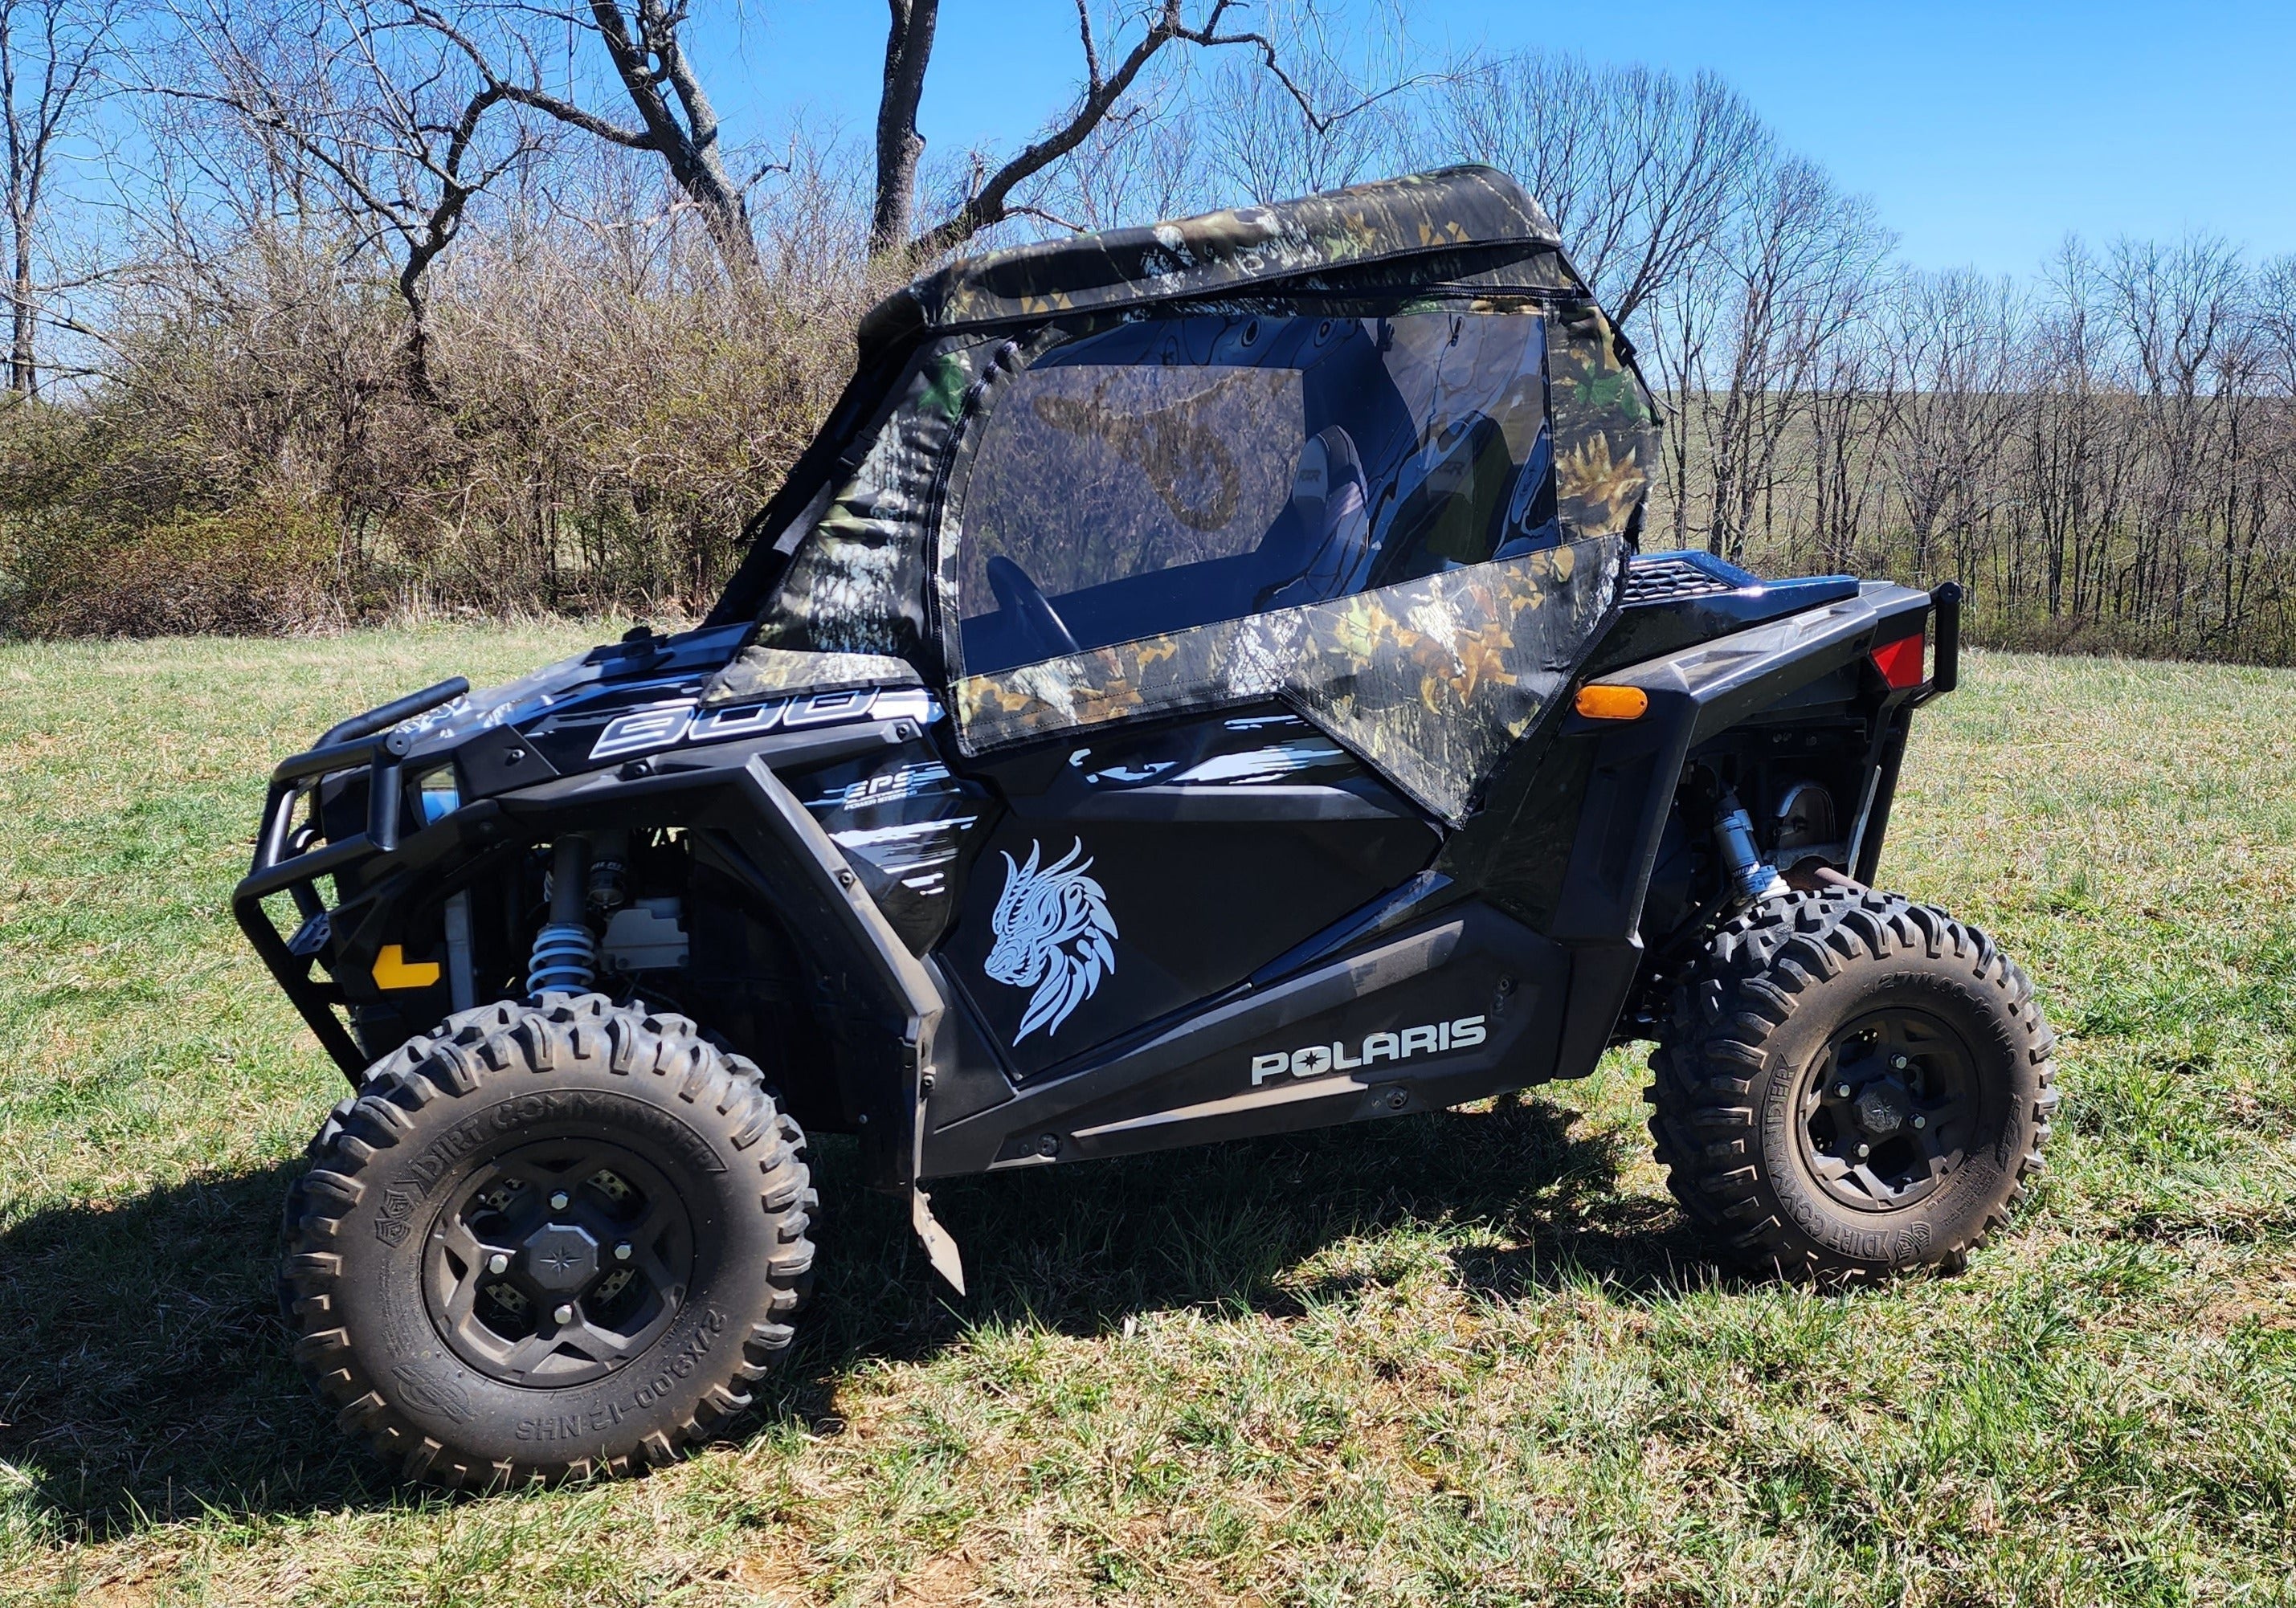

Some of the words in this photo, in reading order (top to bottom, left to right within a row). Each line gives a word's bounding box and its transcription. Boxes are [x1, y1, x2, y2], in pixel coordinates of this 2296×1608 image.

[844, 770, 916, 798] EPS
[844, 799, 876, 810] POWER
[1252, 1015, 1486, 1085] POLARIS
[410, 1117, 484, 1183] DIRT
[1828, 1225, 1881, 1258] DIRT
[515, 1415, 582, 1443] NHS
